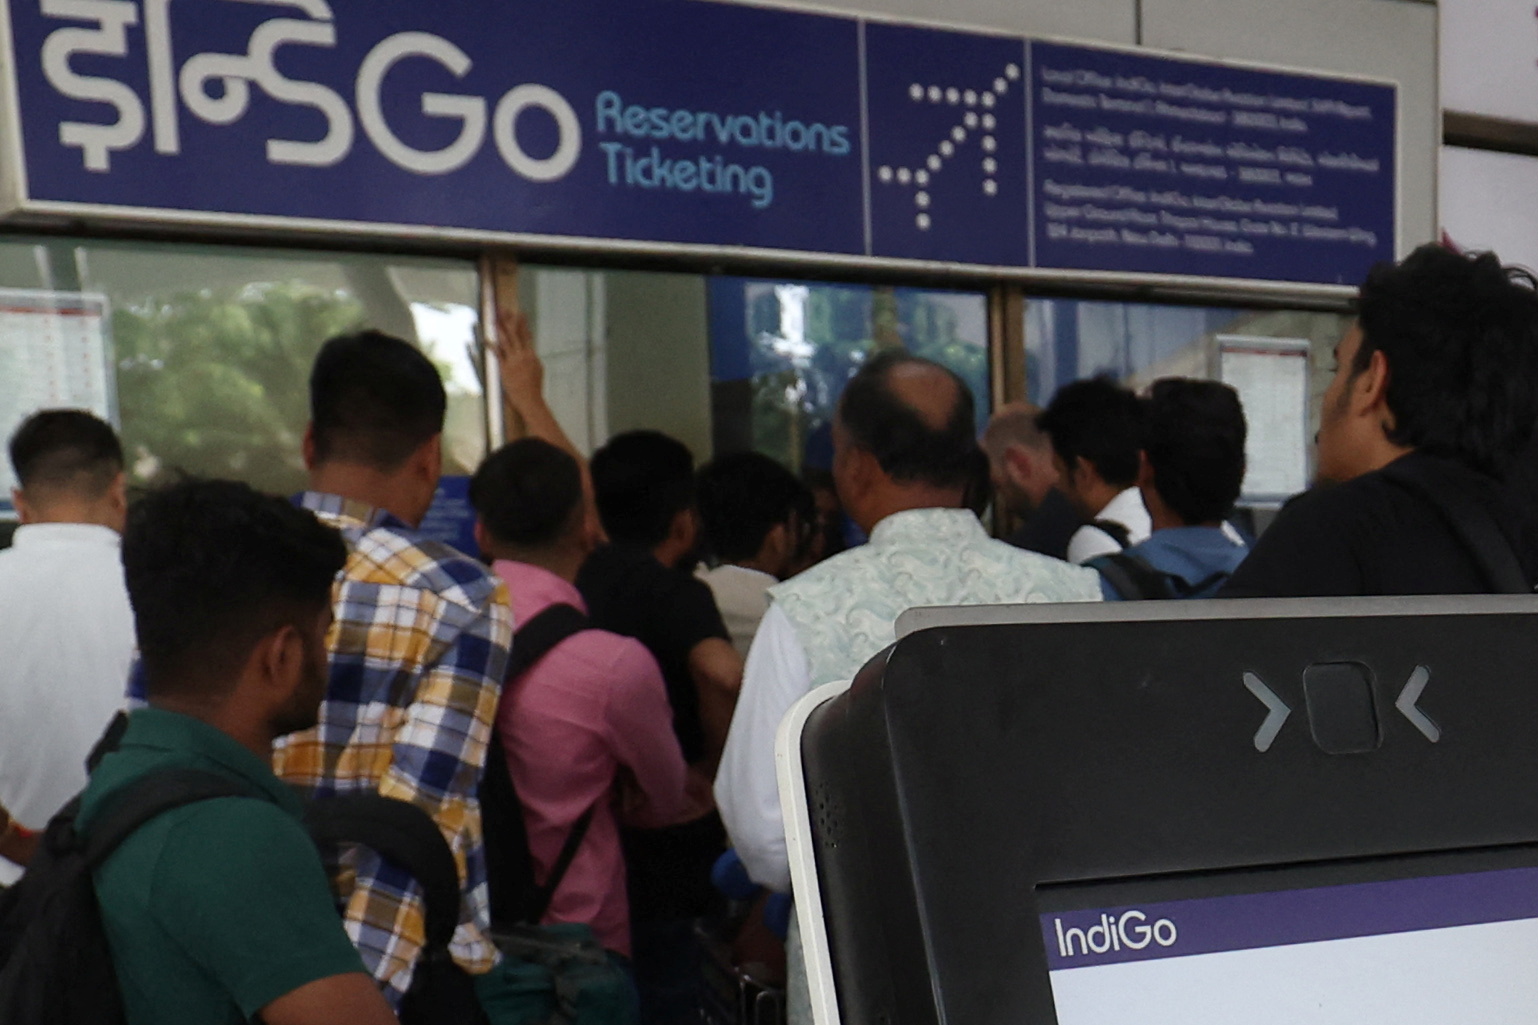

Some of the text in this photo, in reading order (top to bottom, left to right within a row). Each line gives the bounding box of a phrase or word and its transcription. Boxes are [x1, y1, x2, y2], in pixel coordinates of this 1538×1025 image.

[595, 90, 850, 155] Reservations
[599, 141, 774, 209] Ticketing
[1054, 910, 1177, 957] IndiGo
